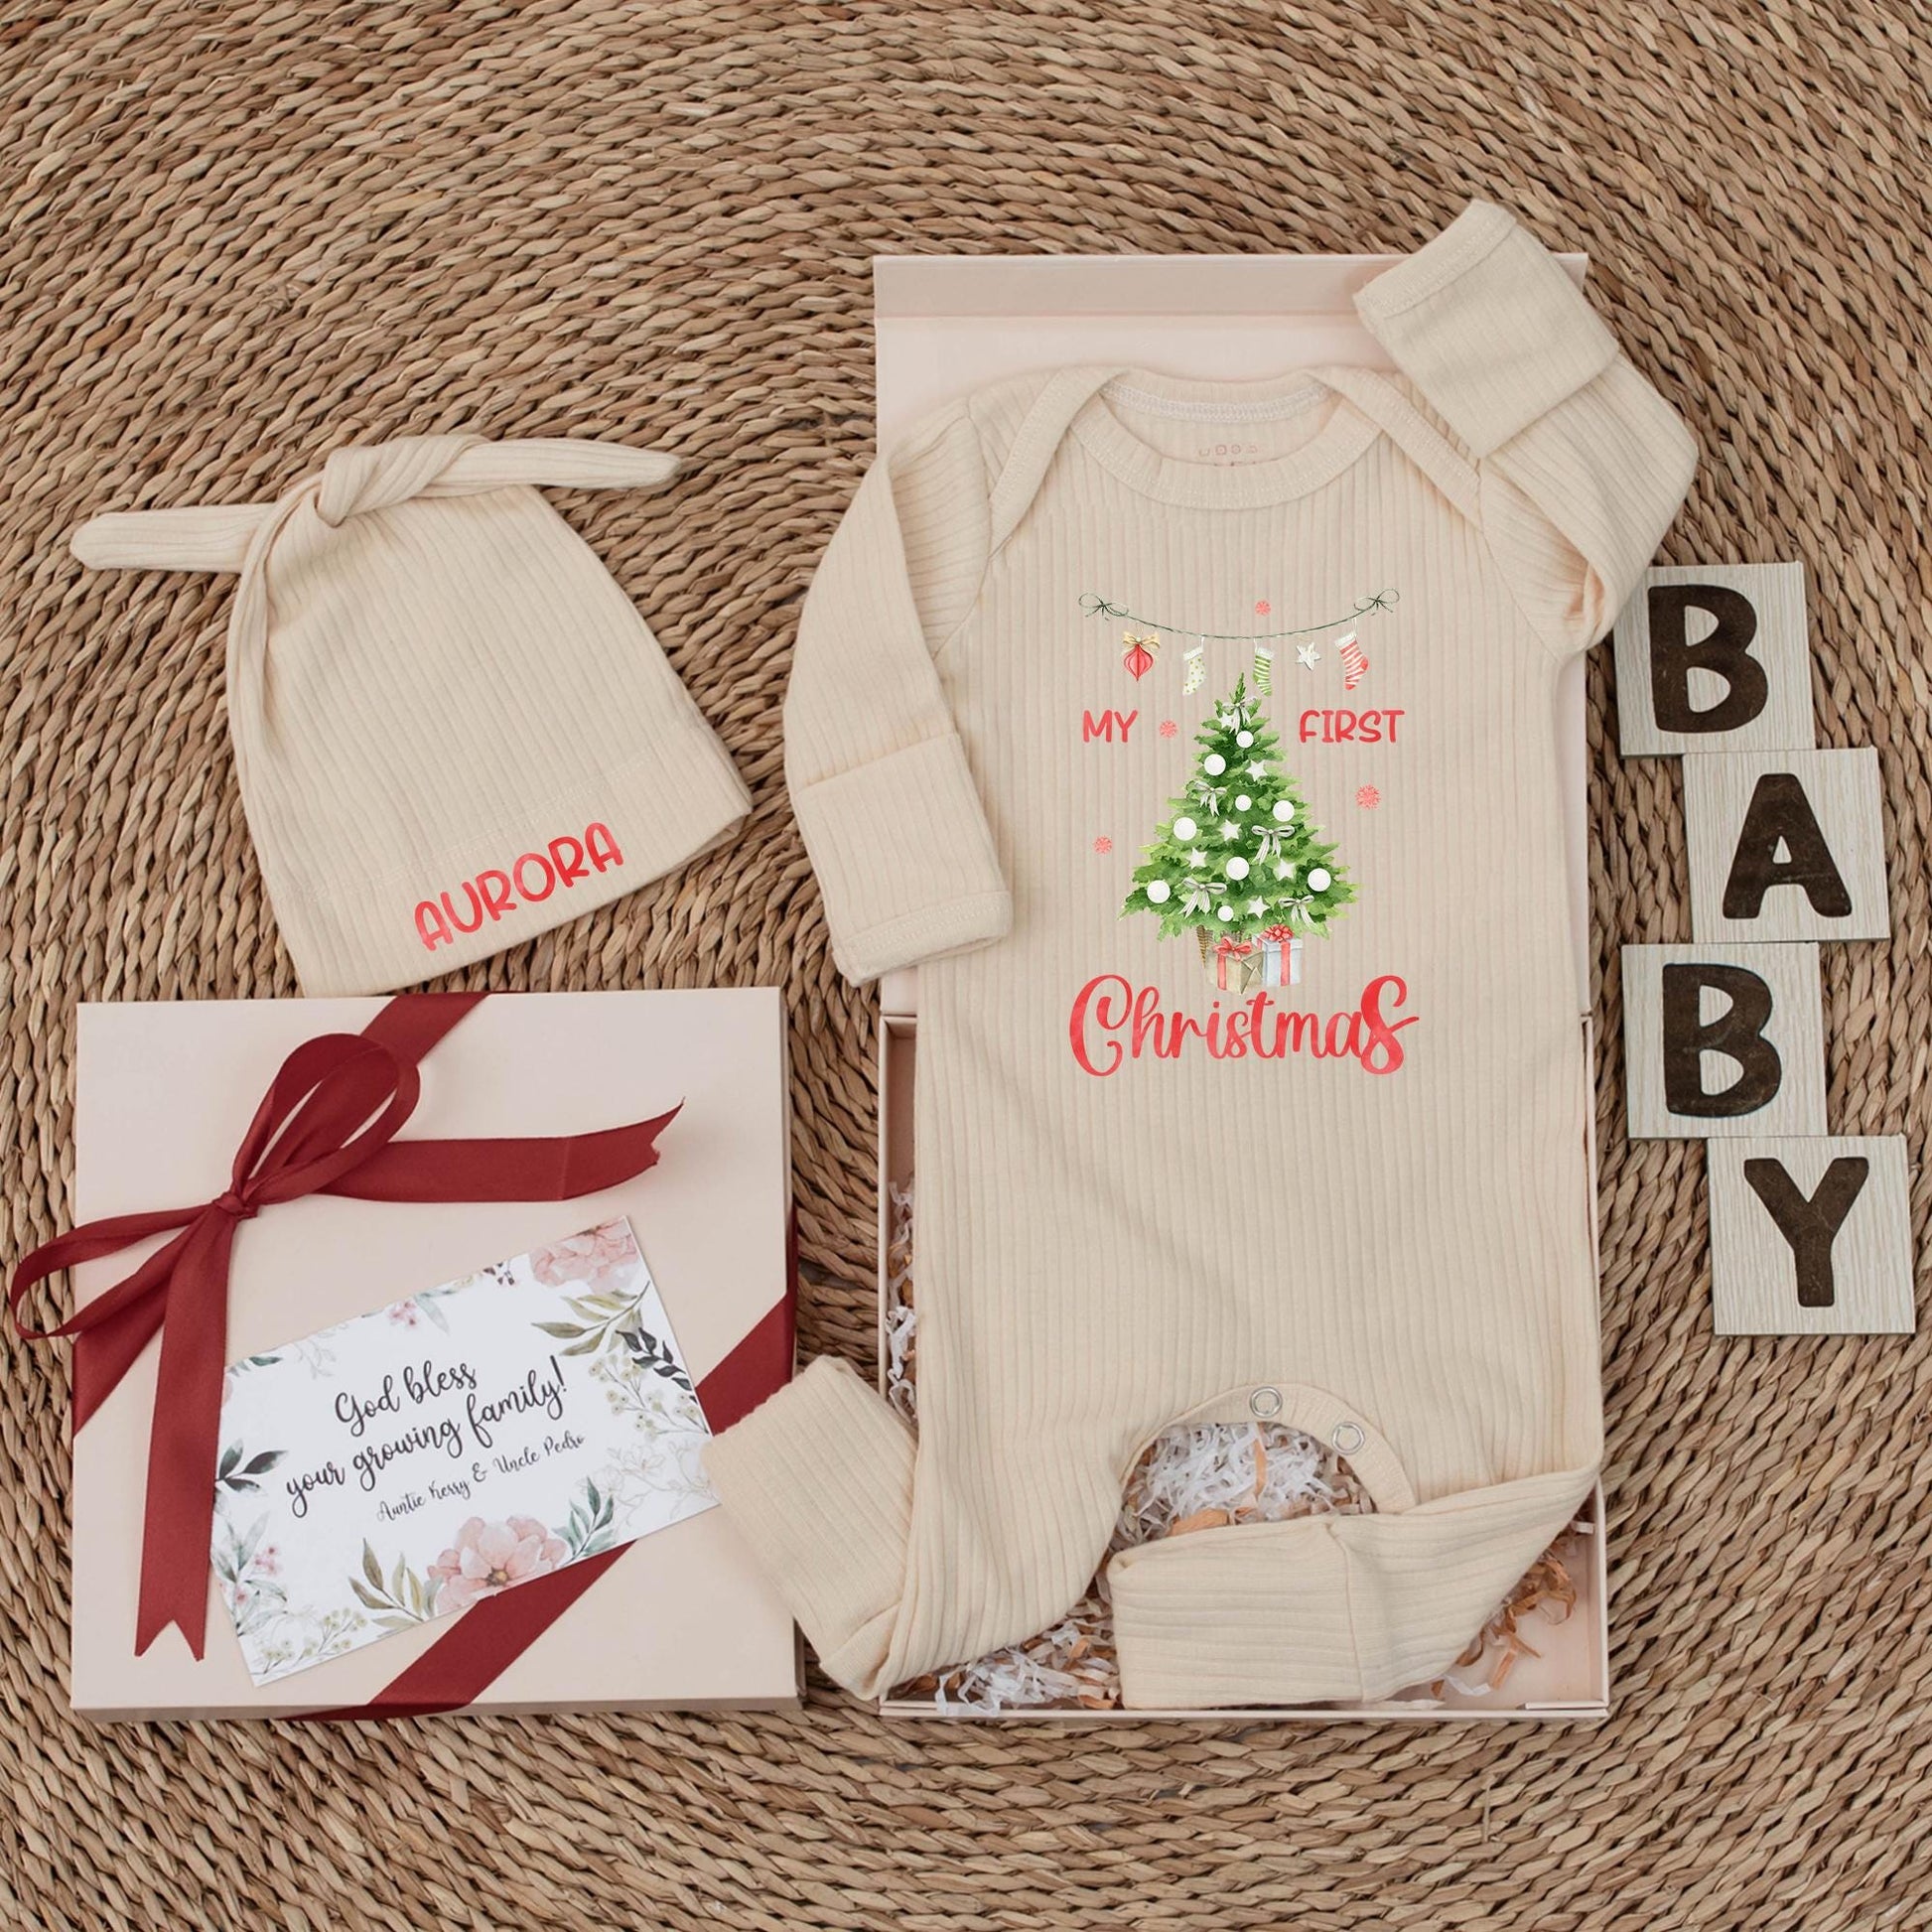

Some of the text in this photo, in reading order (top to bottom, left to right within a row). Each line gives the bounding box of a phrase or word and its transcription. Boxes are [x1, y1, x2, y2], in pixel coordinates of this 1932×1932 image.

[1082, 709, 1406, 744] MY FIRST
[414, 822, 624, 952] AURORA
[1068, 973, 1420, 1077] Christmas
[286, 1354, 568, 1518] your growing family!
[335, 1360, 478, 1438] God bless
[377, 1430, 586, 1522] Auntie Kerry & Uncle Pedro
